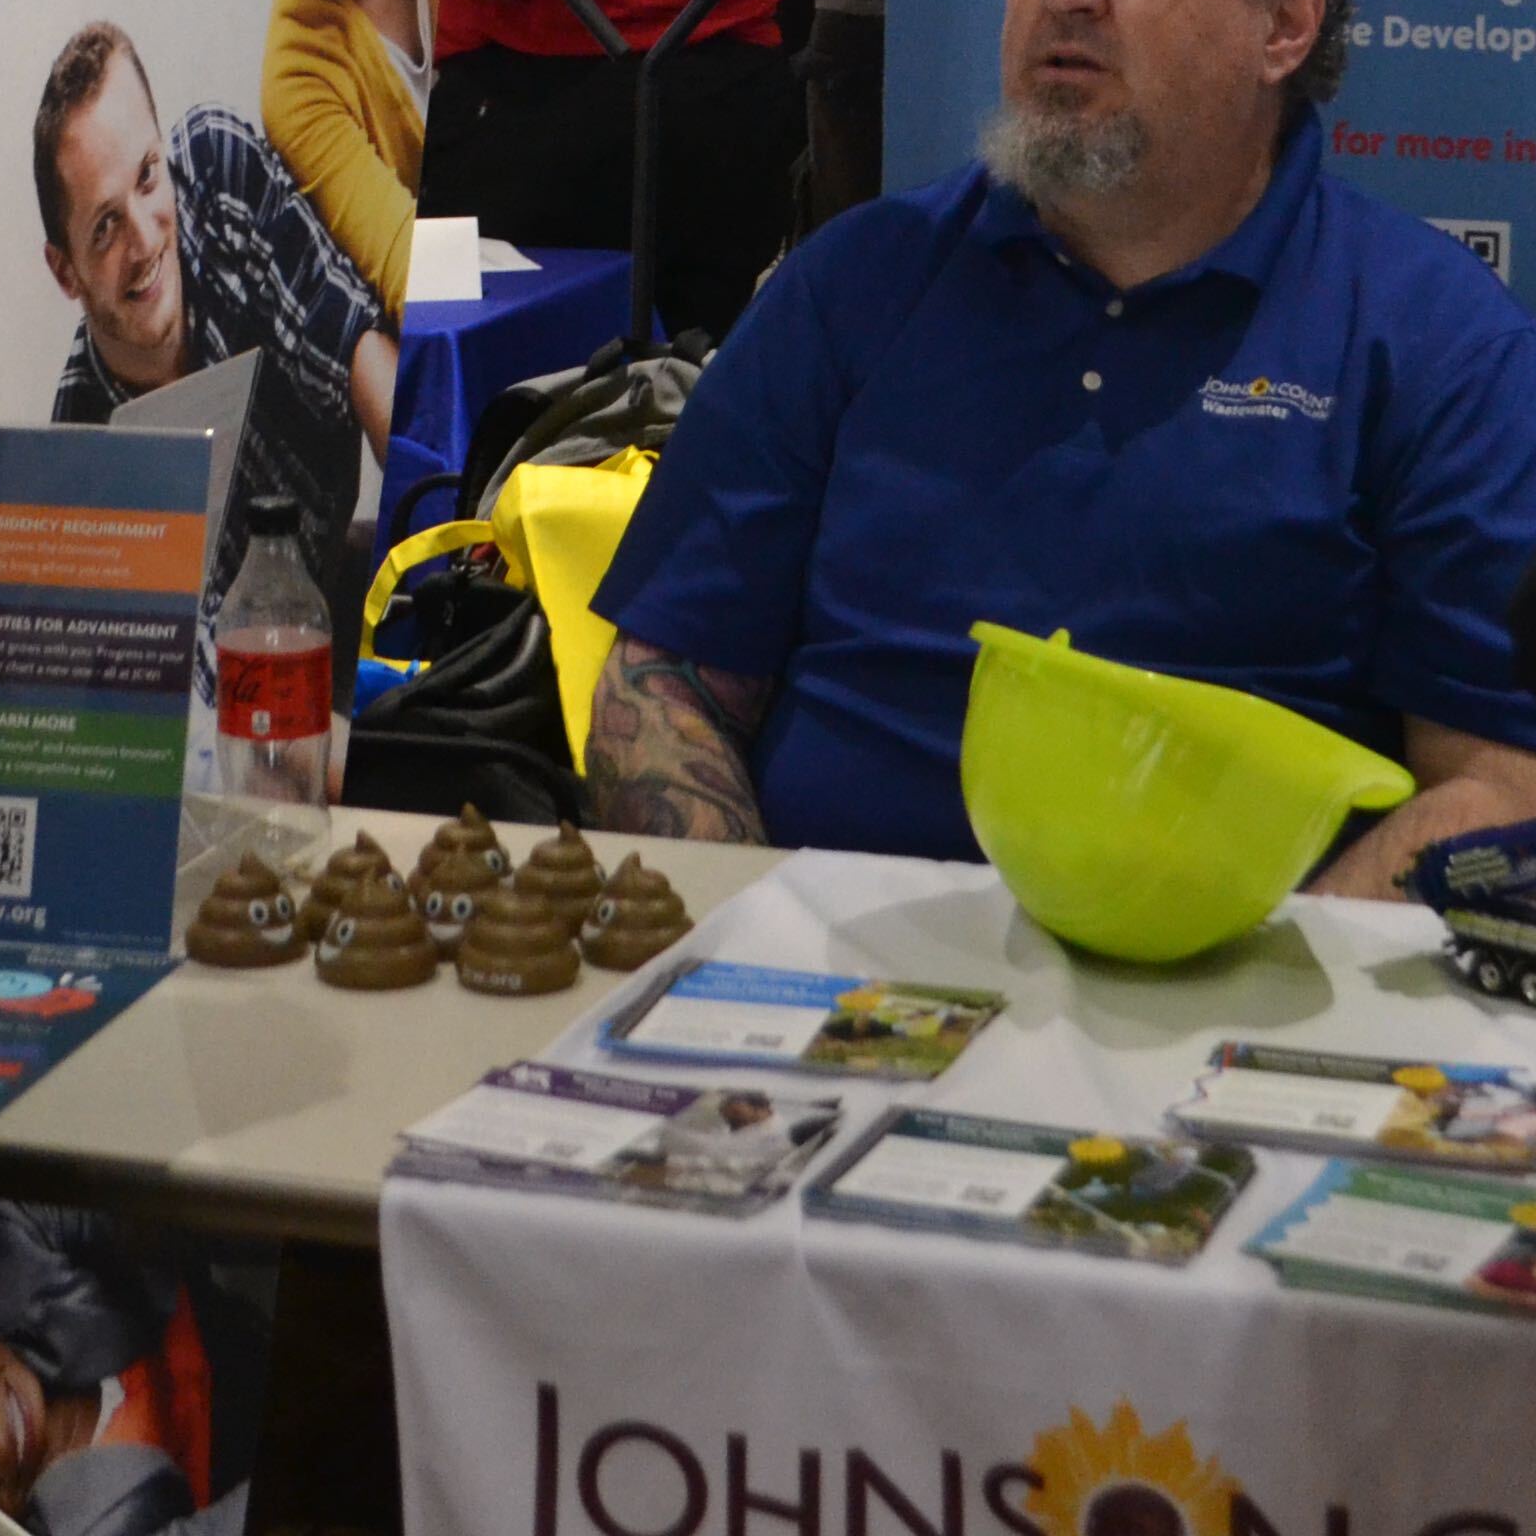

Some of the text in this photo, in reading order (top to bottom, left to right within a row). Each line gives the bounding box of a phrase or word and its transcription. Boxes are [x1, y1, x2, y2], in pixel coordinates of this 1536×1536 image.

[1331, 122, 1384, 155] for
[1396, 129, 1493, 162] more
[64, 518, 167, 539] REQUIREMENT
[35, 617, 63, 634] FOR
[67, 620, 178, 640] ADVANCEMENT
[32, 714, 77, 732] MORE
